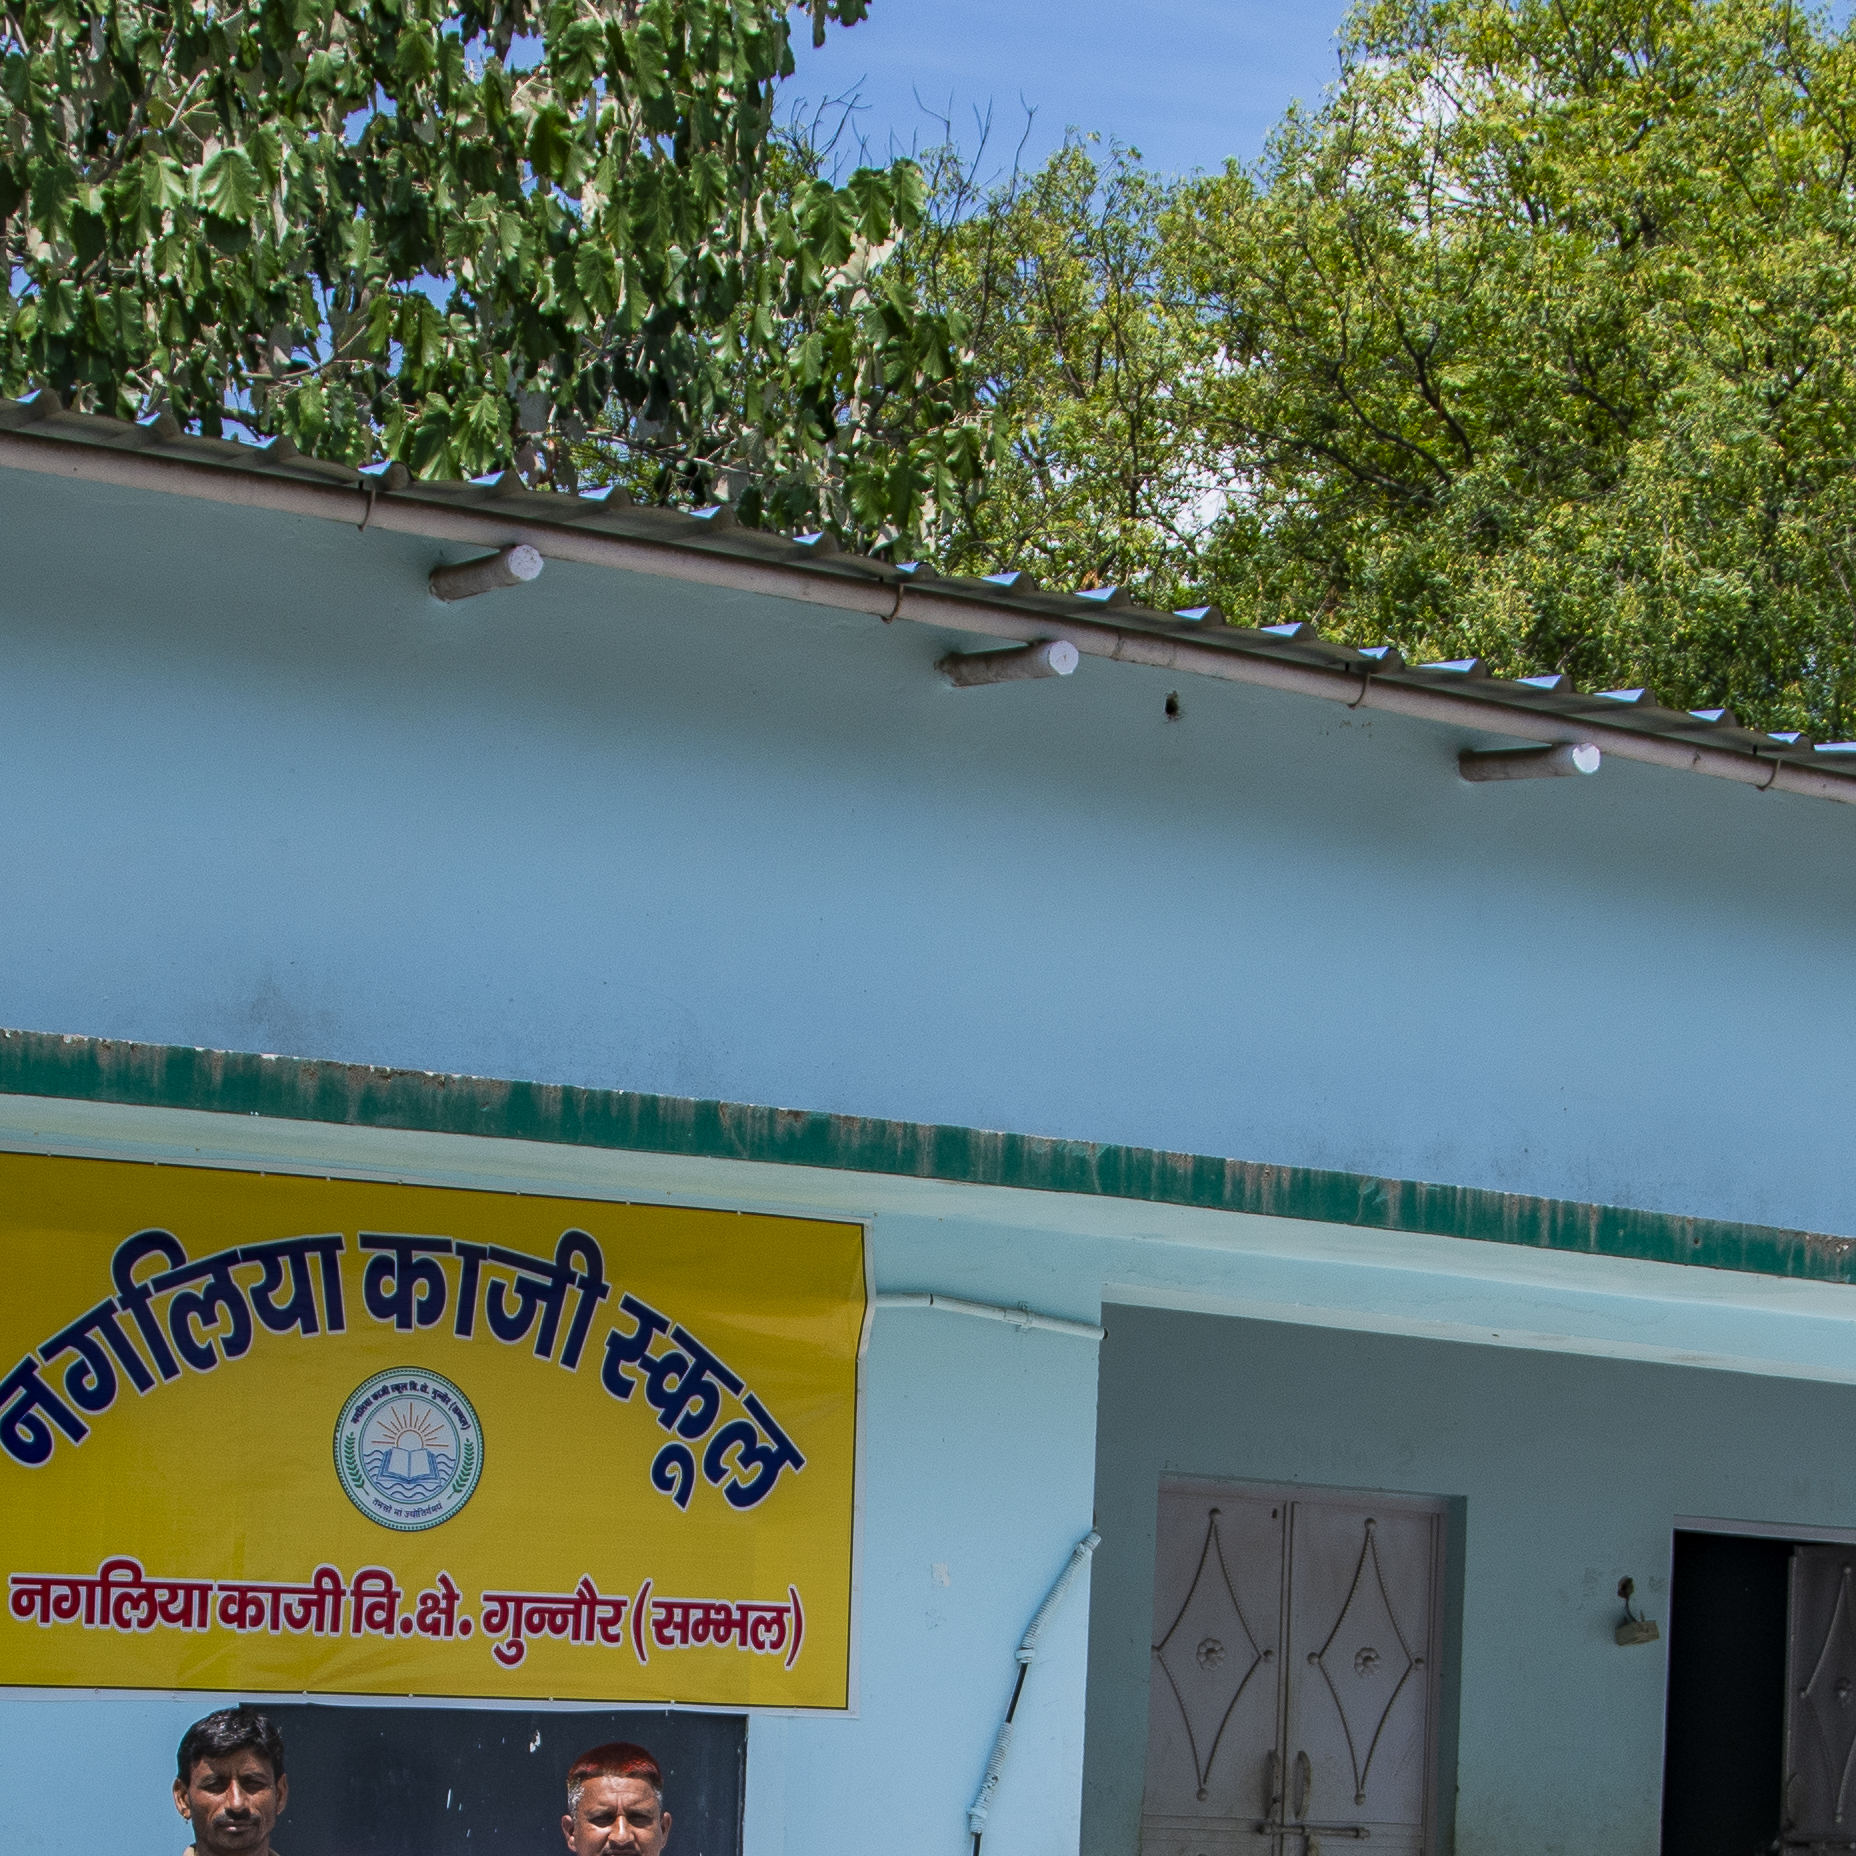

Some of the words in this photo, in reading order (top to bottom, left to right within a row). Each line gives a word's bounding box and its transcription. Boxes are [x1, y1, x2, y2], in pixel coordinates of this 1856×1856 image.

[358, 1229, 609, 1371] काजी
[601, 1294, 806, 1510] स्कूल
[11, 1558, 213, 1629] नगलिया
[217, 1567, 346, 1633] काजी
[482, 1574, 628, 1665] गुन्नौर
[632, 1581, 803, 1667] (सम्भल)
